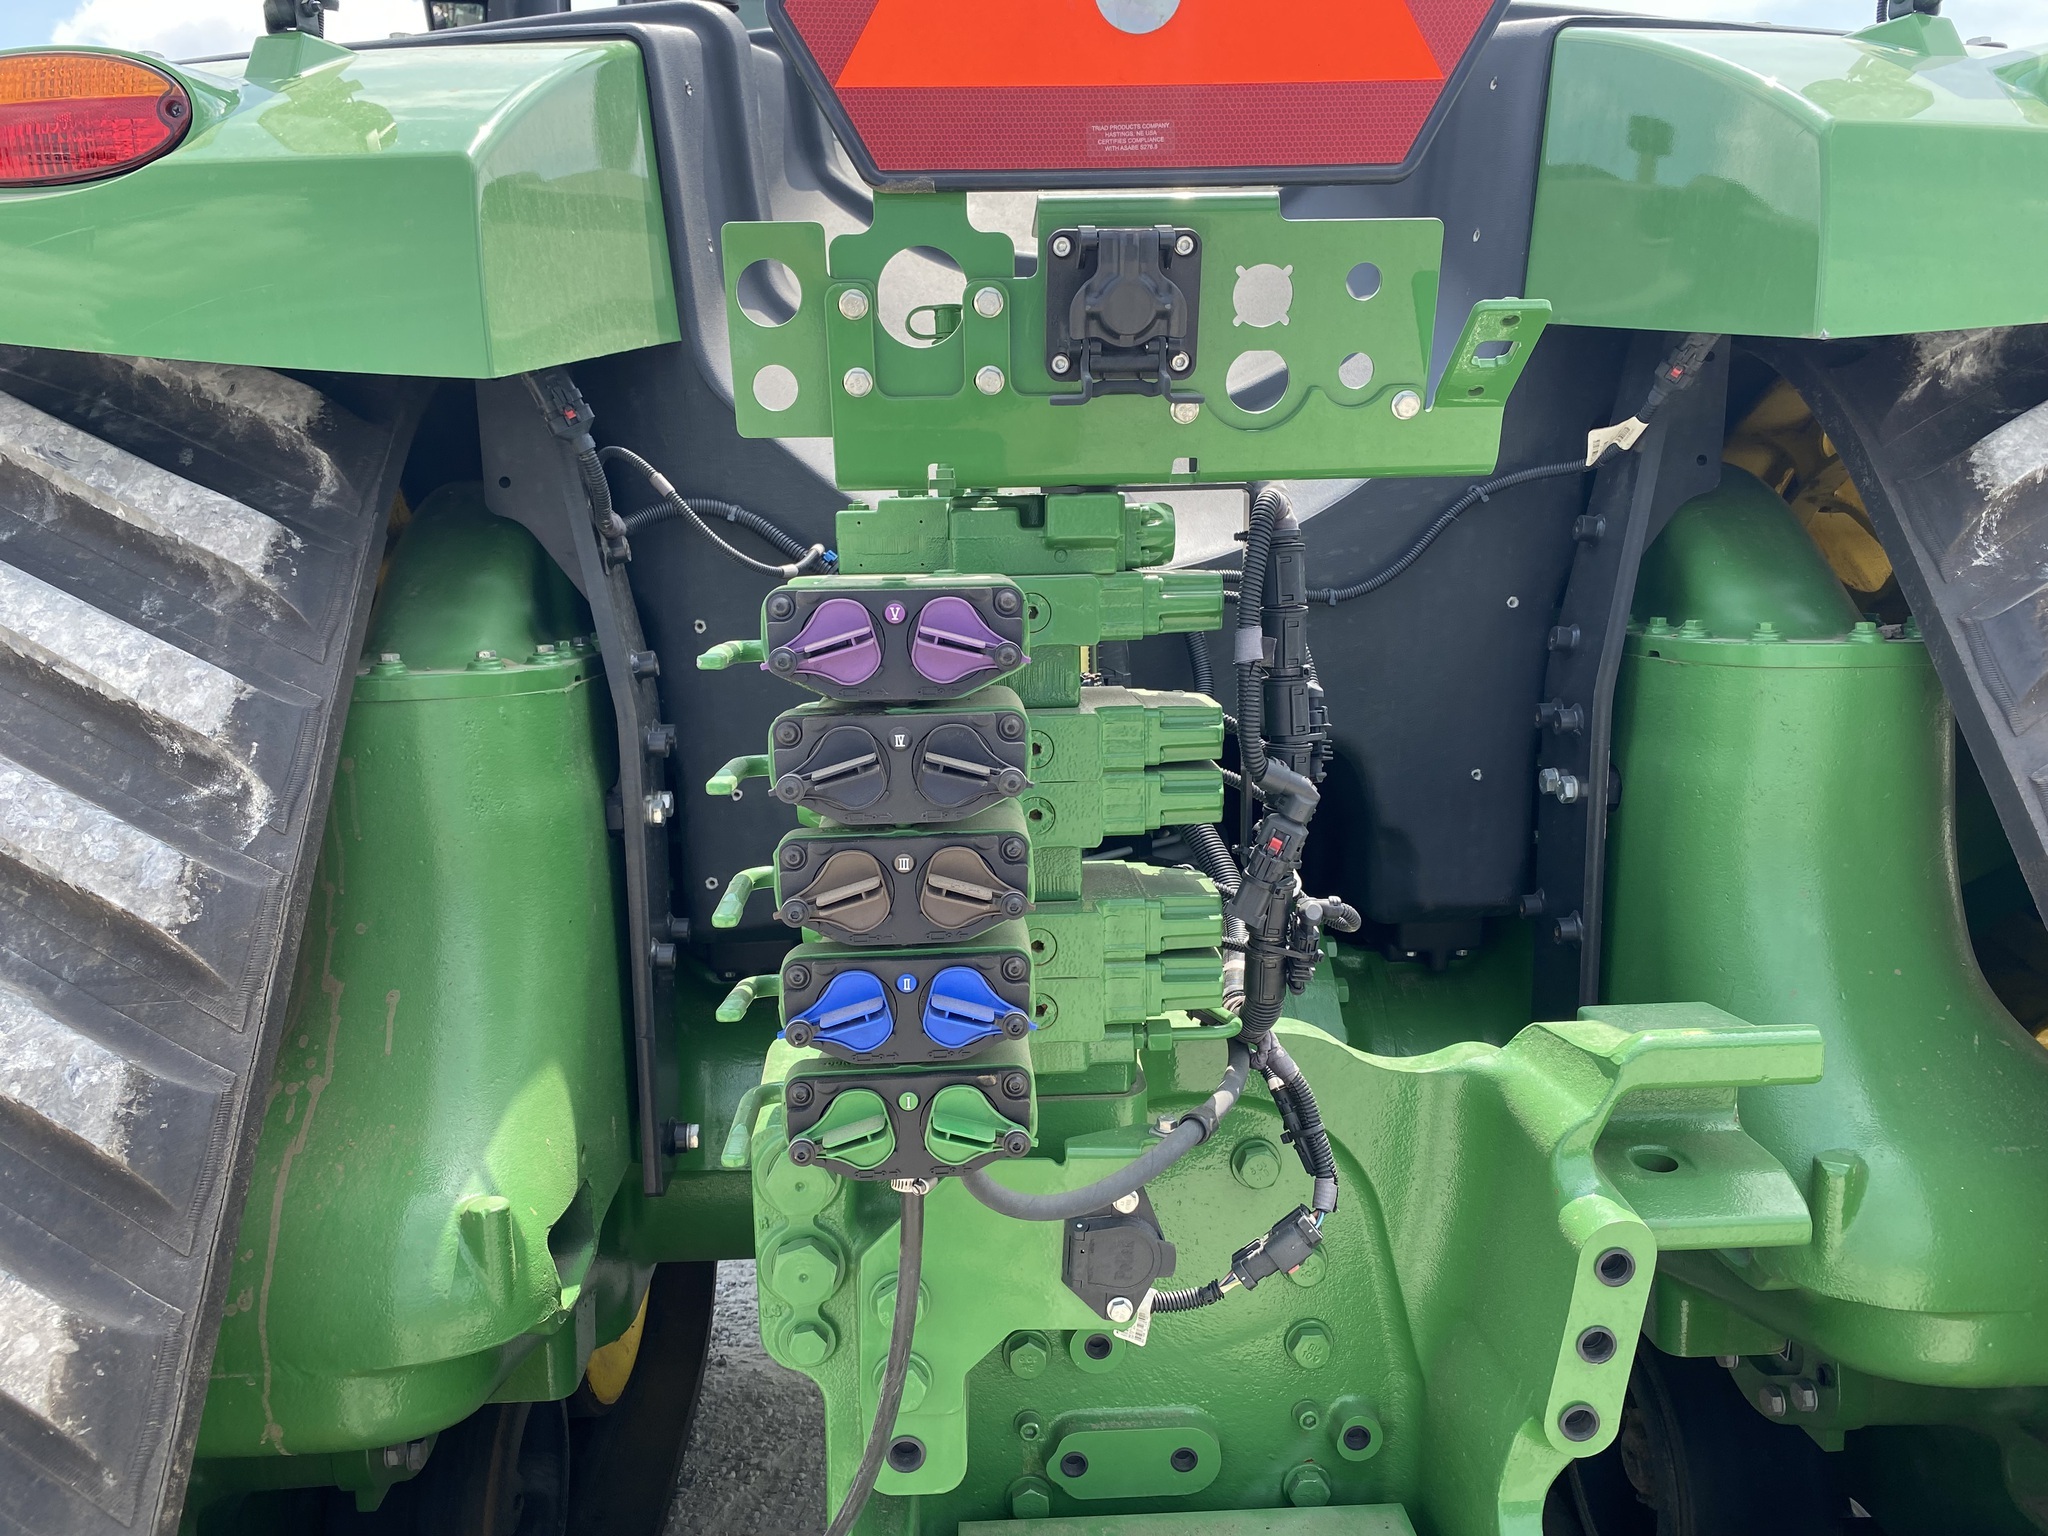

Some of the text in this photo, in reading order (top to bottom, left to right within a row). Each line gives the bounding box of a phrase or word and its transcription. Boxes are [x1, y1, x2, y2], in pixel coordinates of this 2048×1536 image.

[890, 607, 900, 620] V
[895, 735, 905, 747] IV
[899, 858, 909, 870] III
[904, 978, 910, 990] II
